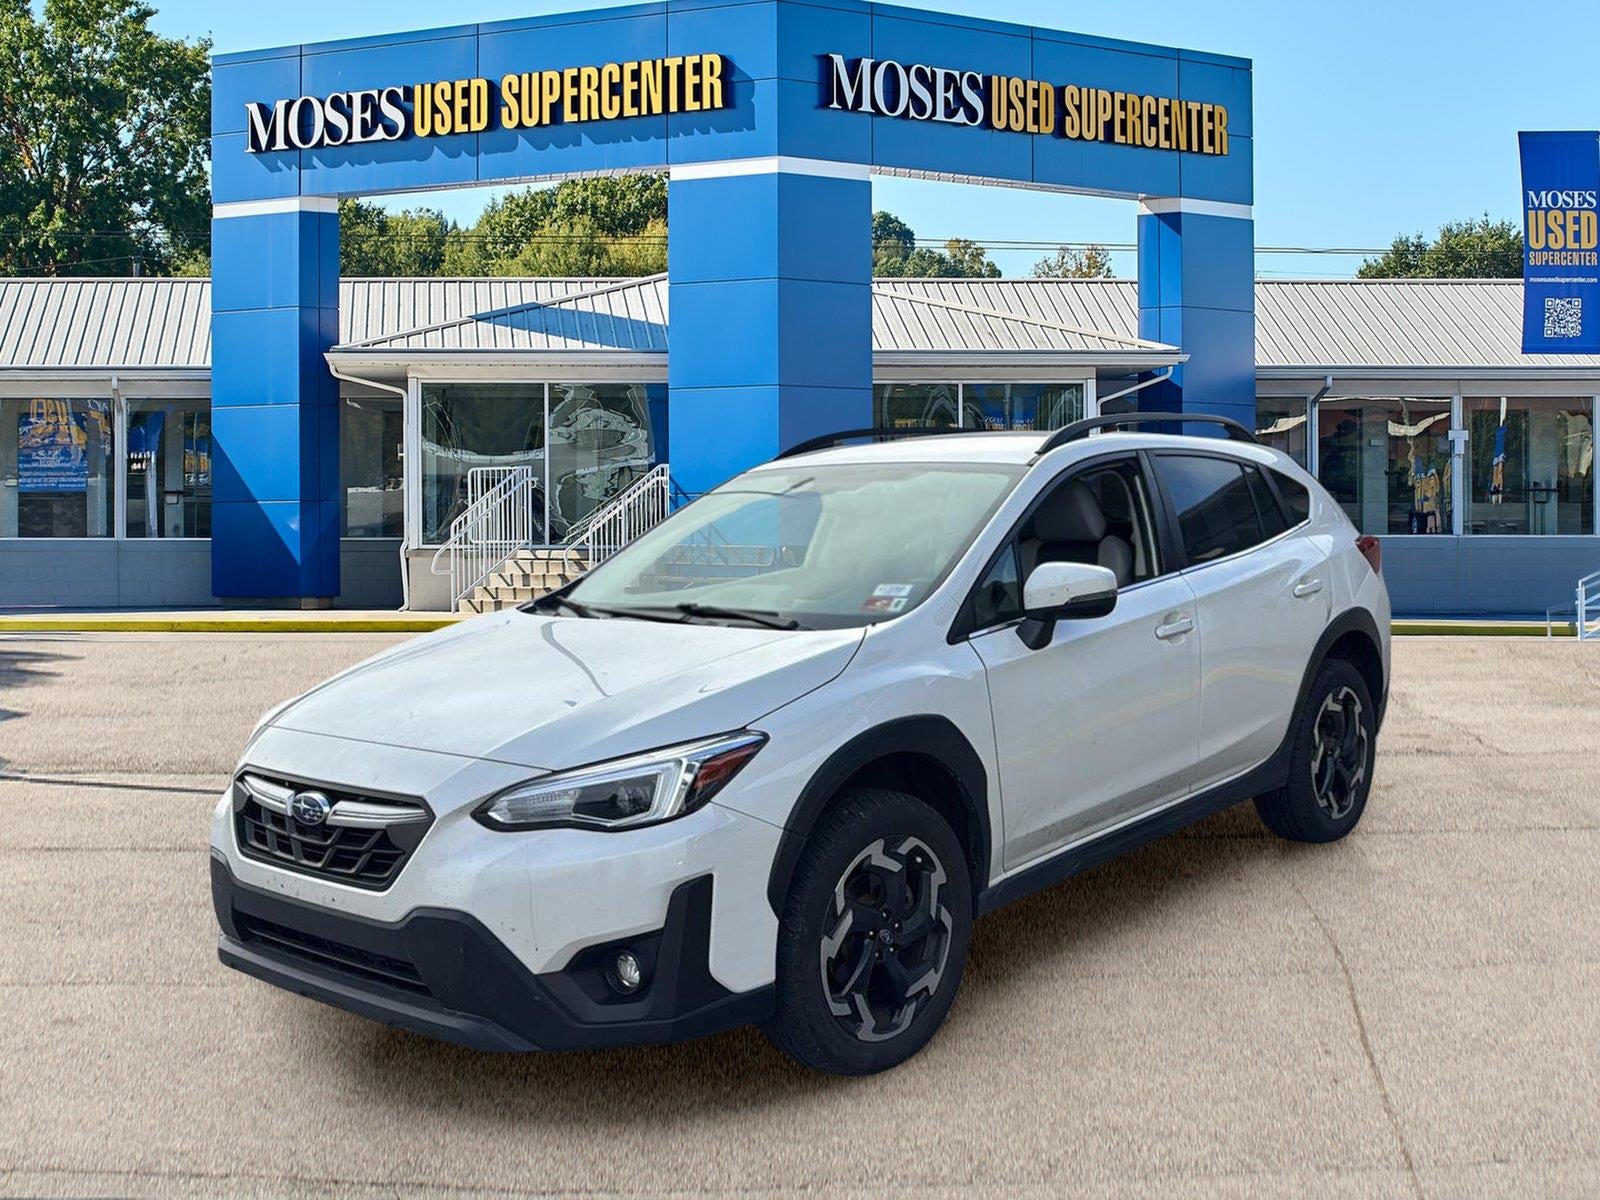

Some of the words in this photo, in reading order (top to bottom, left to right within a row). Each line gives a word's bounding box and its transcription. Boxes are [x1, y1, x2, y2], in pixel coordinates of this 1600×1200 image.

[243, 86, 407, 154] MOSES
[412, 78, 488, 138] USED
[500, 53, 723, 129] SUPERCENTER
[828, 53, 984, 127] MOSES
[990, 75, 1055, 135] USED
[1064, 84, 1229, 156] SUPERCENTER
[1527, 190, 1597, 209] MOSES
[1528, 210, 1598, 249] USED
[1529, 251, 1598, 266] SUPERCENTER
